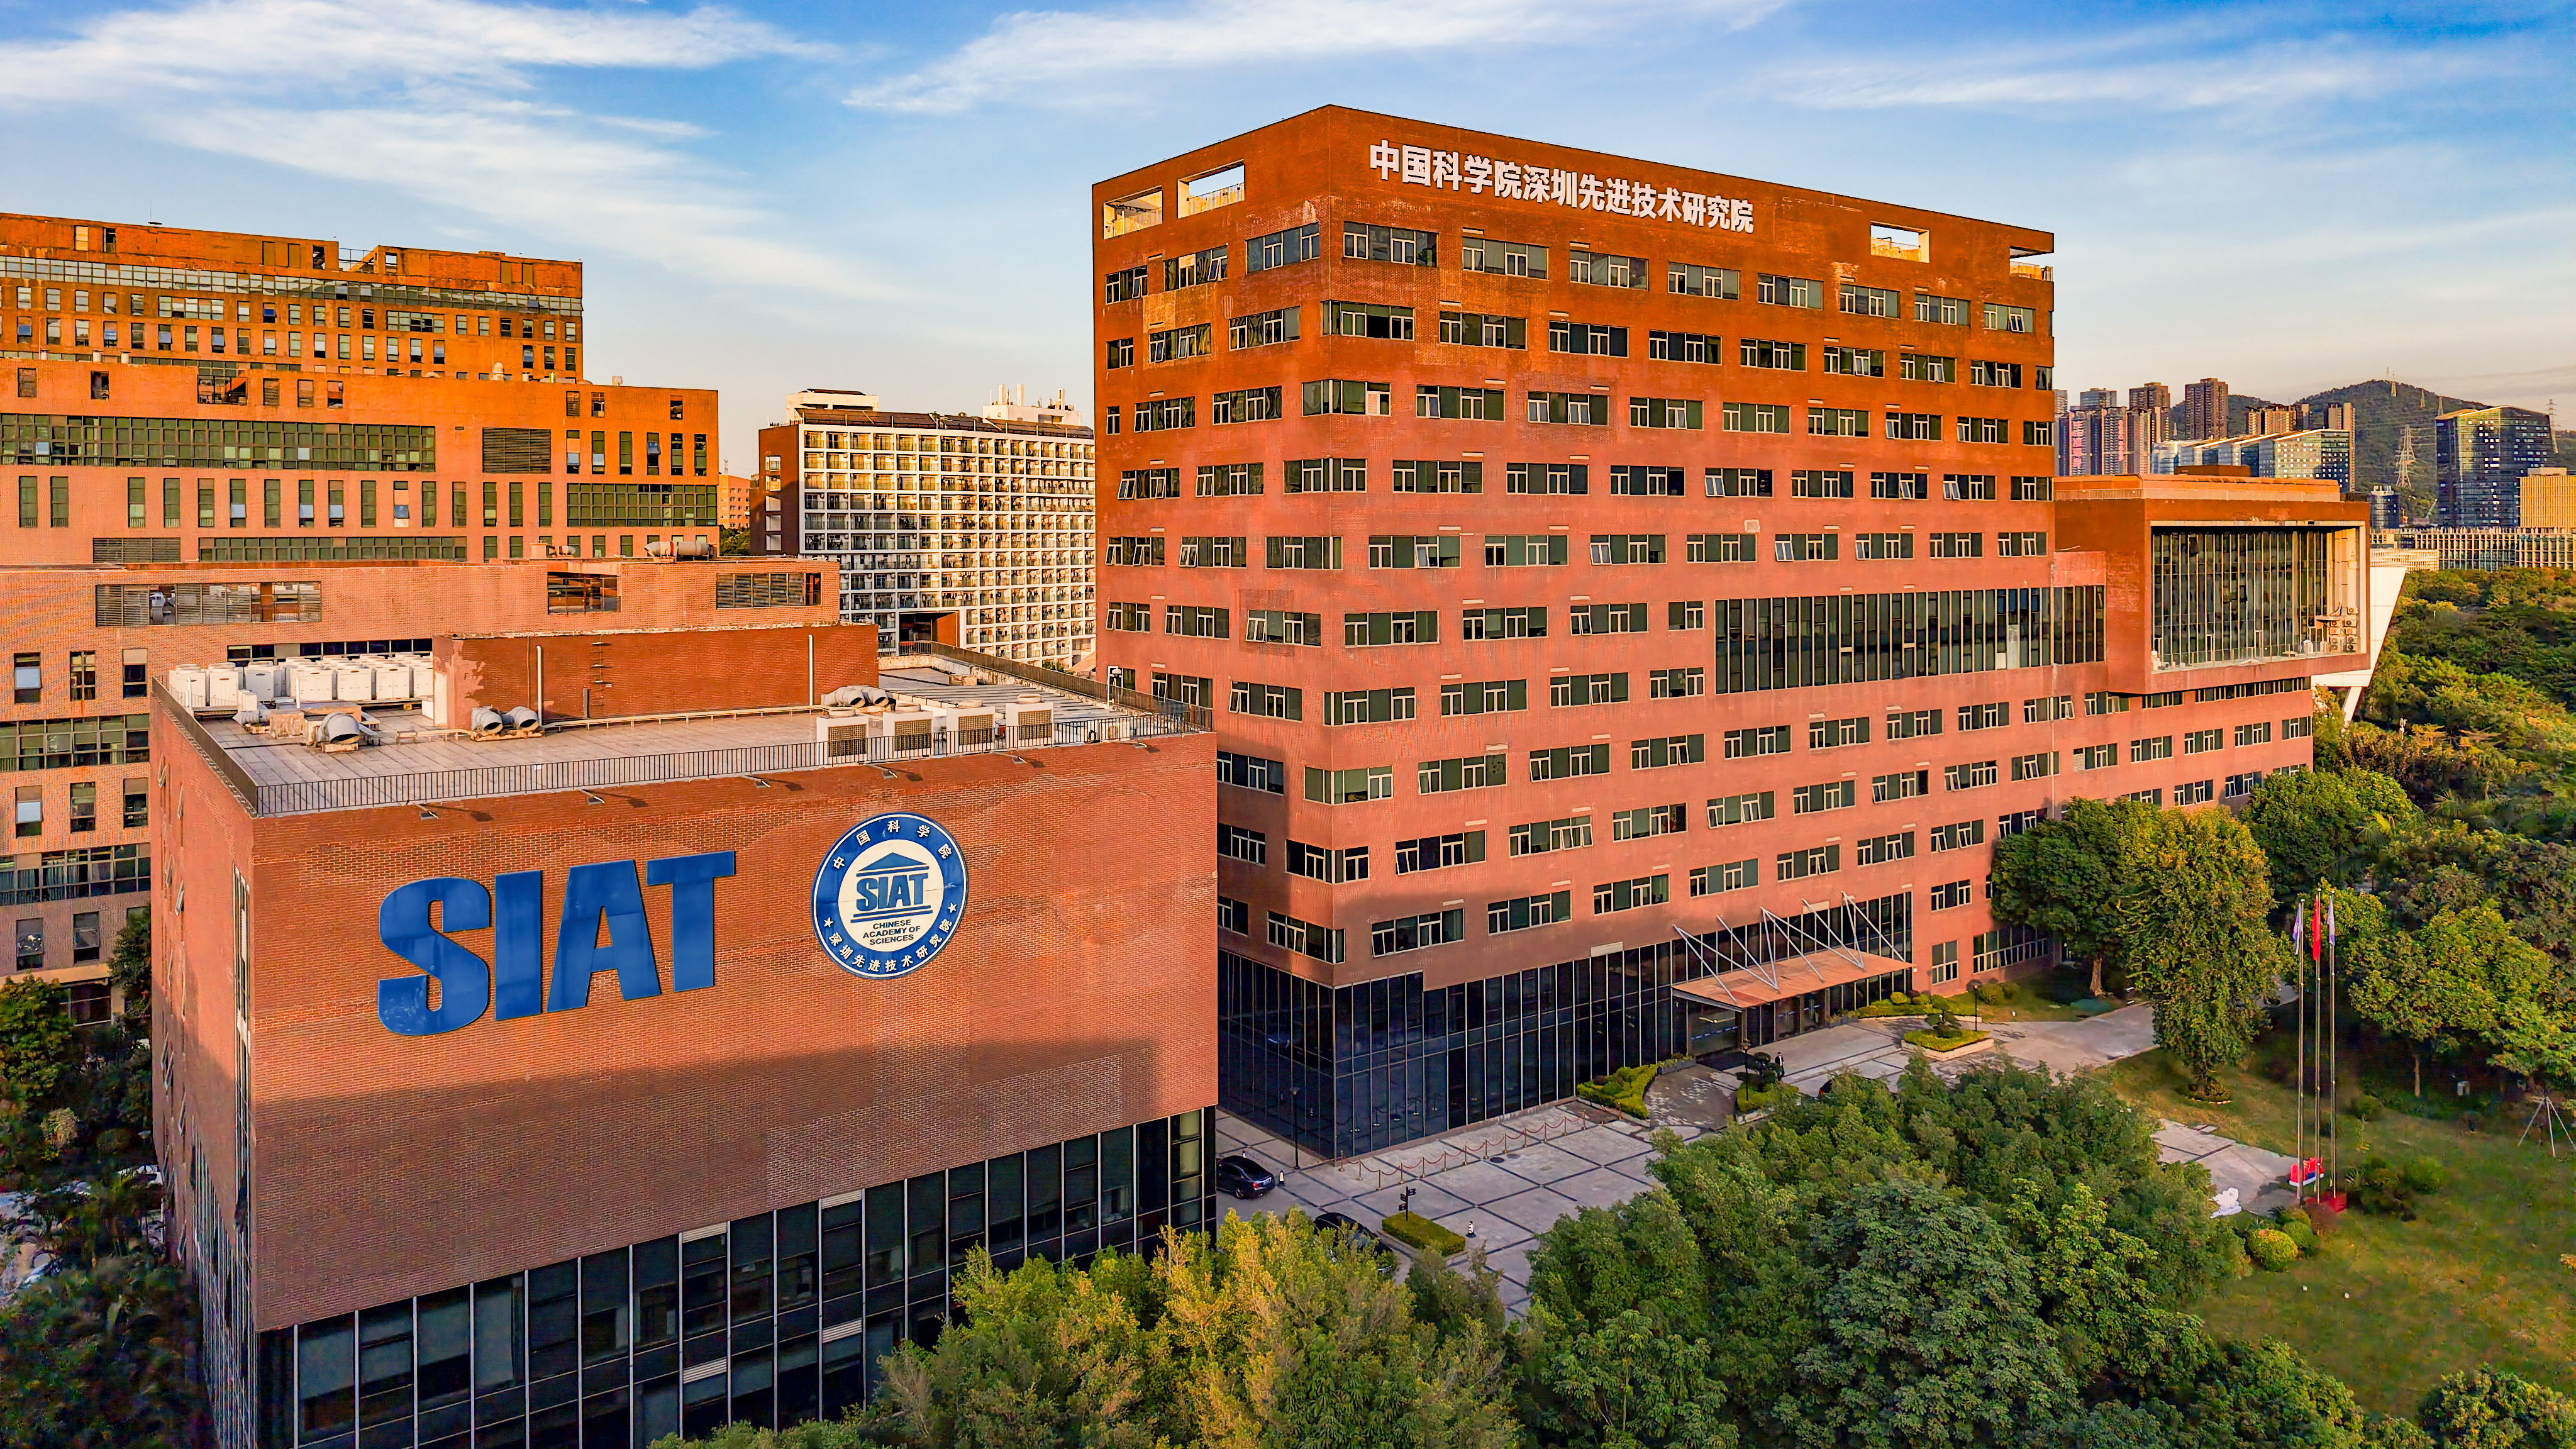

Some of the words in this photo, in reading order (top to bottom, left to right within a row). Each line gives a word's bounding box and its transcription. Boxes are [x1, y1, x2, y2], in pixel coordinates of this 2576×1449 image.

[1370, 140, 1755, 233] 中国科学院深圳先进技术研究院
[833, 819, 952, 869] 中国科学院
[856, 872, 929, 911] SIAT
[378, 850, 735, 1036] SIAT
[828, 918, 952, 972] 深圳先进技术研究院
[862, 927, 907, 938] ACADEMY
[869, 934, 914, 945] SCIENCES
[872, 919, 912, 930] CHINESE
